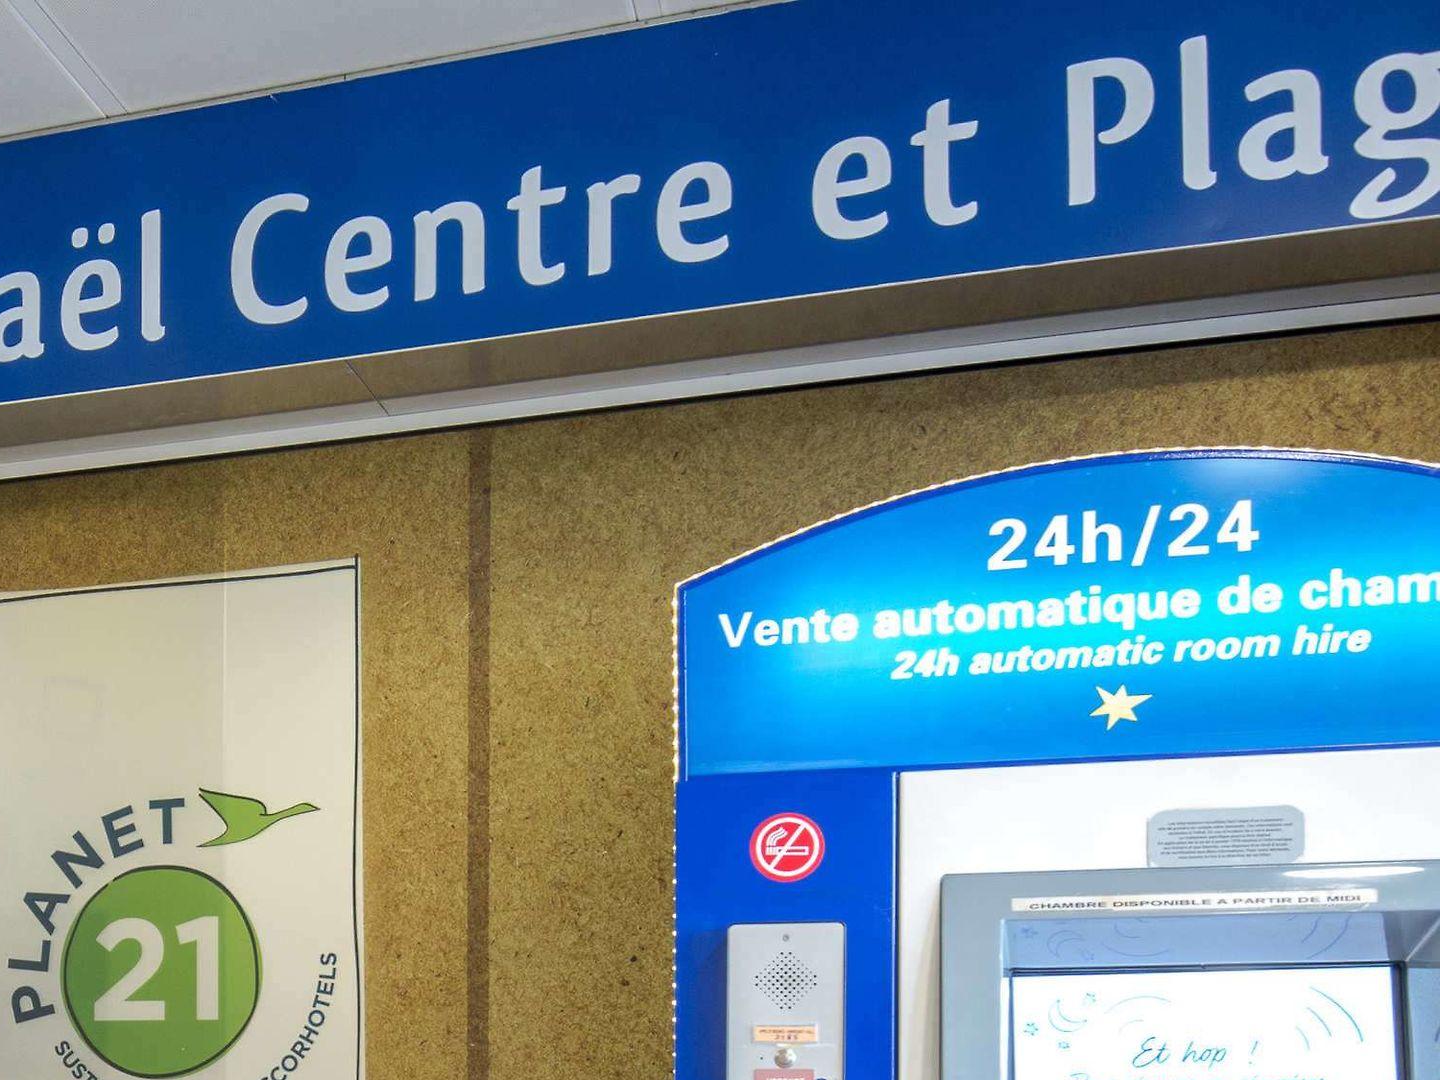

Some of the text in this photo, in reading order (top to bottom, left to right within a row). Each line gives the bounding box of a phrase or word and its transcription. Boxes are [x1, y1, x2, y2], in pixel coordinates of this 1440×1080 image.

[229, 160, 735, 326] Centre
[810, 97, 979, 242] et
[1064, 34, 1440, 220] Plag
[986, 499, 1261, 572] 24h/24
[718, 567, 1440, 650] Vente automatique de cham
[890, 625, 1373, 681] 24h automatic room hire
[7, 798, 185, 1024] PLANET
[1029, 901, 1108, 910] CHAMBRE
[1112, 898, 1211, 908] DISPONIBLE
[1233, 896, 1292, 905] PARTIR
[1326, 894, 1362, 903] MIDI
[93, 915, 220, 1022] 21
[1132, 1036, 1171, 1068] Et
[1182, 1041, 1227, 1069] hop
